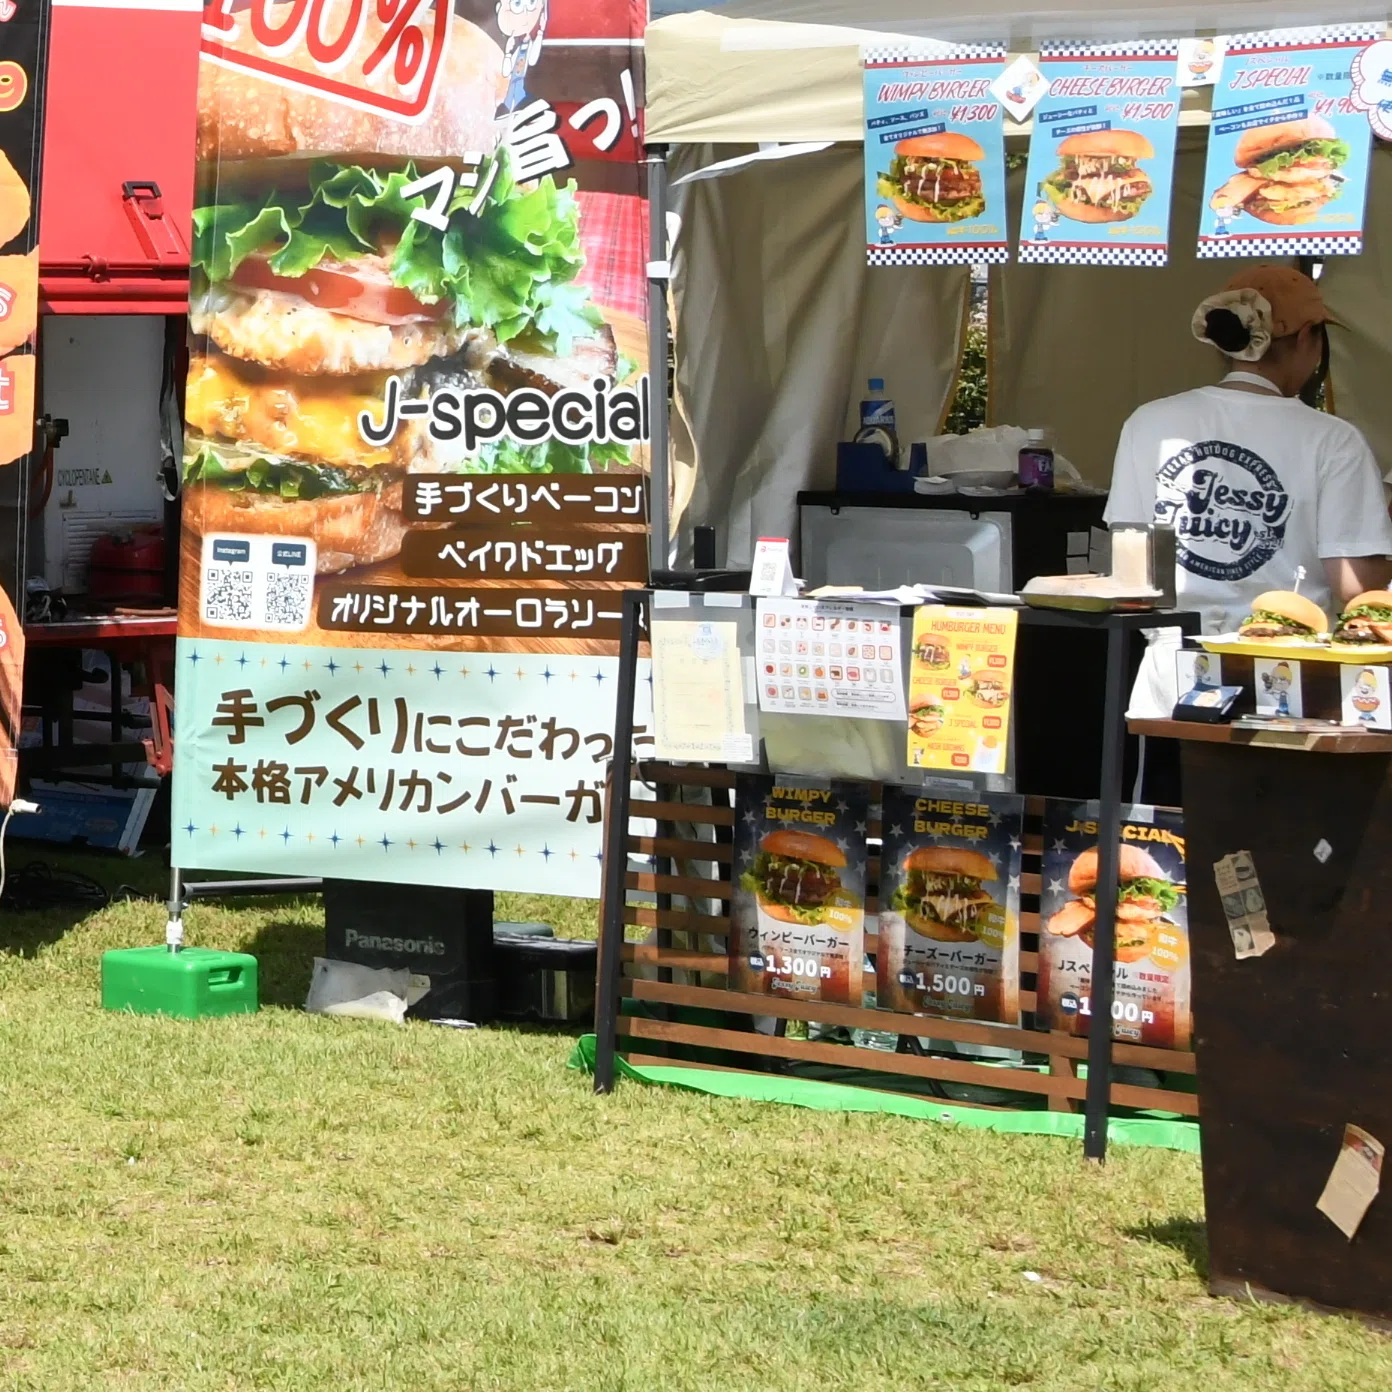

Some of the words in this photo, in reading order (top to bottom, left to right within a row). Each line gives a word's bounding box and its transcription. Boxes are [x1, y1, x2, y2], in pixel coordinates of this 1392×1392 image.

[415, 481, 643, 515] 手づくりベーコン
[1186, 469, 1289, 524] Jessy
[438, 540, 624, 573] ベイクドエッグ
[983, 622, 1006, 635] MENU
[212, 757, 607, 825] 本格アメリカンバーガ
[772, 786, 832, 804] WIMPY
[765, 806, 836, 825] BURGER
[915, 798, 990, 818] CHEESE
[913, 819, 989, 839] BURGER
[1082, 821, 1185, 843] SCIAL
[828, 909, 853, 925] 100%
[345, 928, 446, 956] Panasonic
[748, 926, 850, 949] ウィンピーバーガー
[1152, 948, 1179, 963] 100%
[1057, 959, 1128, 980] Jスペル
[1079, 996, 1154, 1024] 100円
